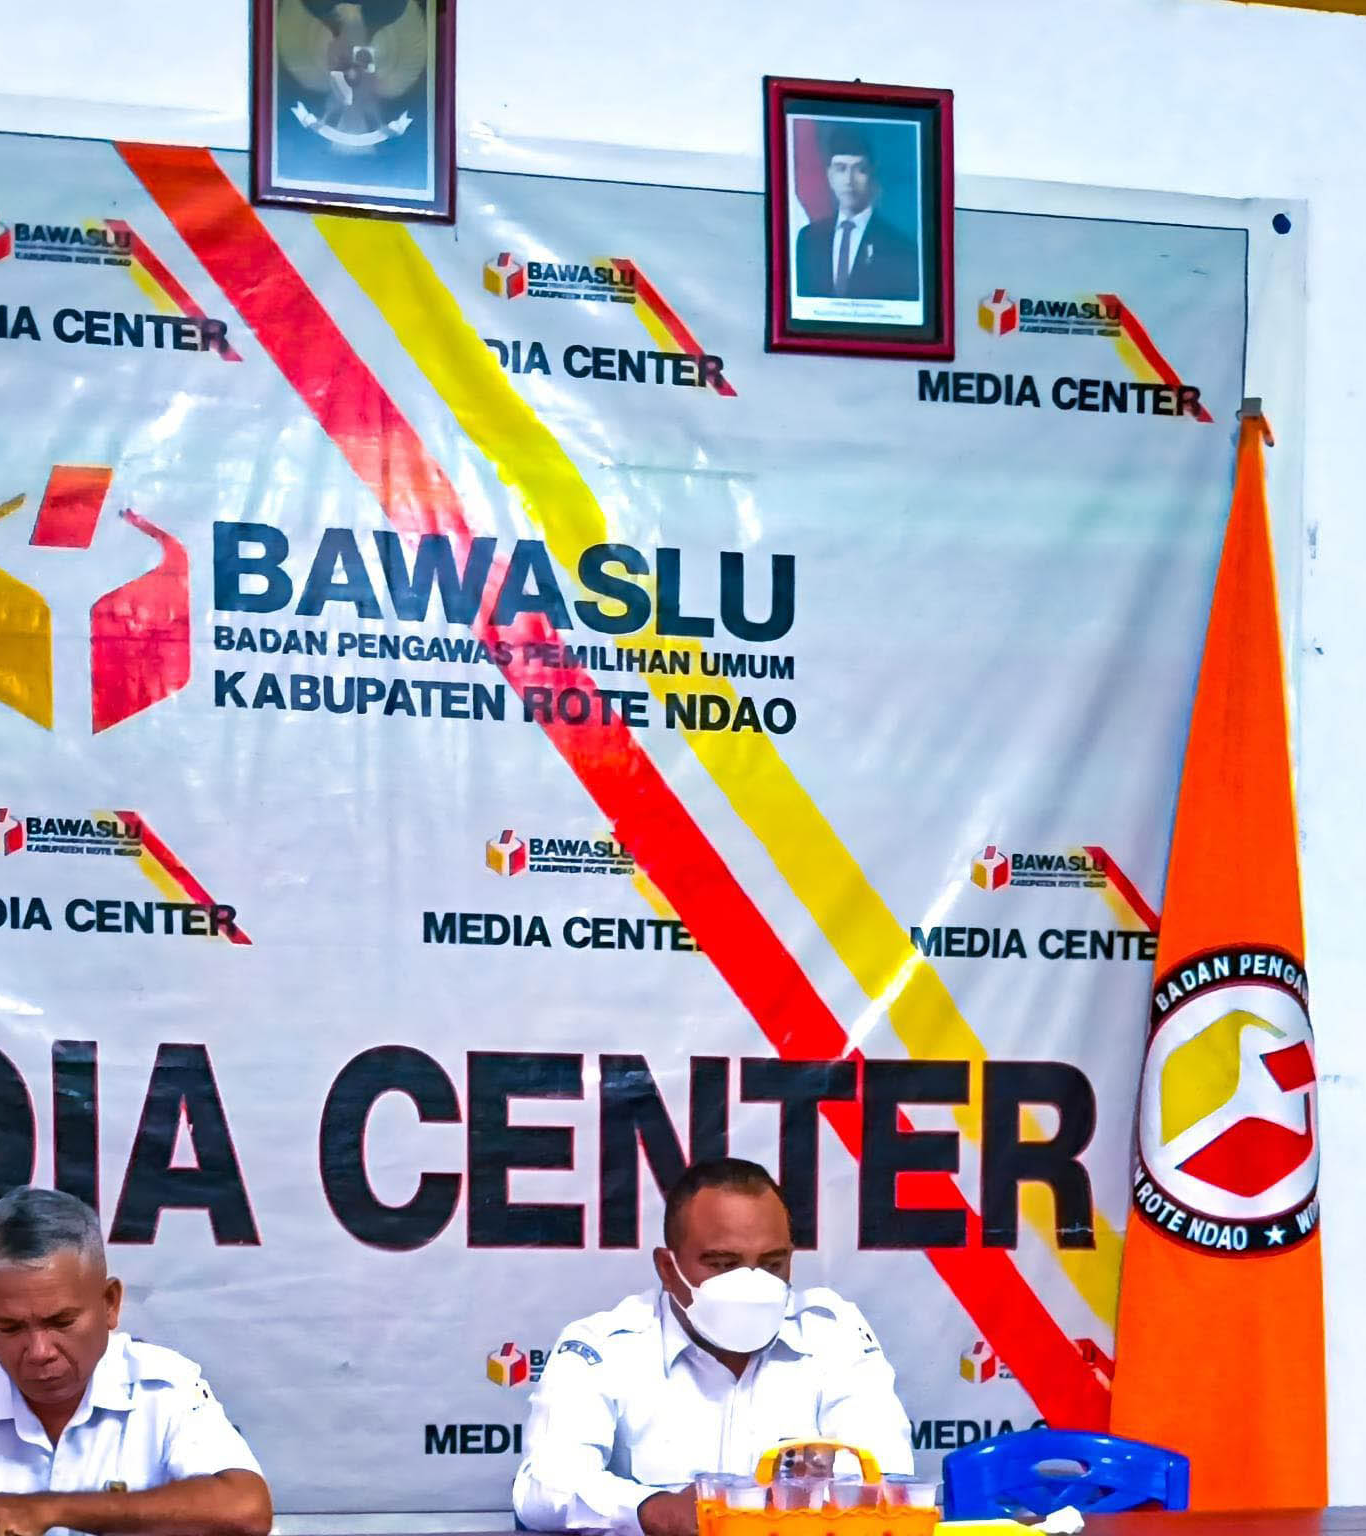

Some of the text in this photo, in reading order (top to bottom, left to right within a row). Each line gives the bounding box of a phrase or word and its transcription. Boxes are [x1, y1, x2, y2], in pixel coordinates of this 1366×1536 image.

[15, 223, 131, 248] BAWASLU
[528, 262, 635, 286] BAWASLU
[53, 308, 229, 352] CENTER
[1019, 298, 1121, 320] BAWASLU
[484, 338, 724, 388] DIA CENTER
[918, 370, 1202, 417] MEDIA CENTER
[213, 521, 795, 642] BAWASLU
[215, 626, 795, 680] BADAN PENGAWAS PEMILIHAN UMUM
[214, 670, 797, 734] KABUPATEN ROTE NDAO
[26, 817, 141, 839] BAWASLU
[1012, 853, 1107, 872] BAWASLU
[65, 899, 237, 936] CENTER
[423, 911, 703, 951] MEDIA CENTE
[910, 926, 1159, 960] MEDIA CENTE
[1155, 956, 1230, 1012] BADAN
[319, 1045, 1097, 1251] CENTER
[1137, 1182, 1249, 1250] ROTE NDAO
[425, 1424, 522, 1454] MEDI
